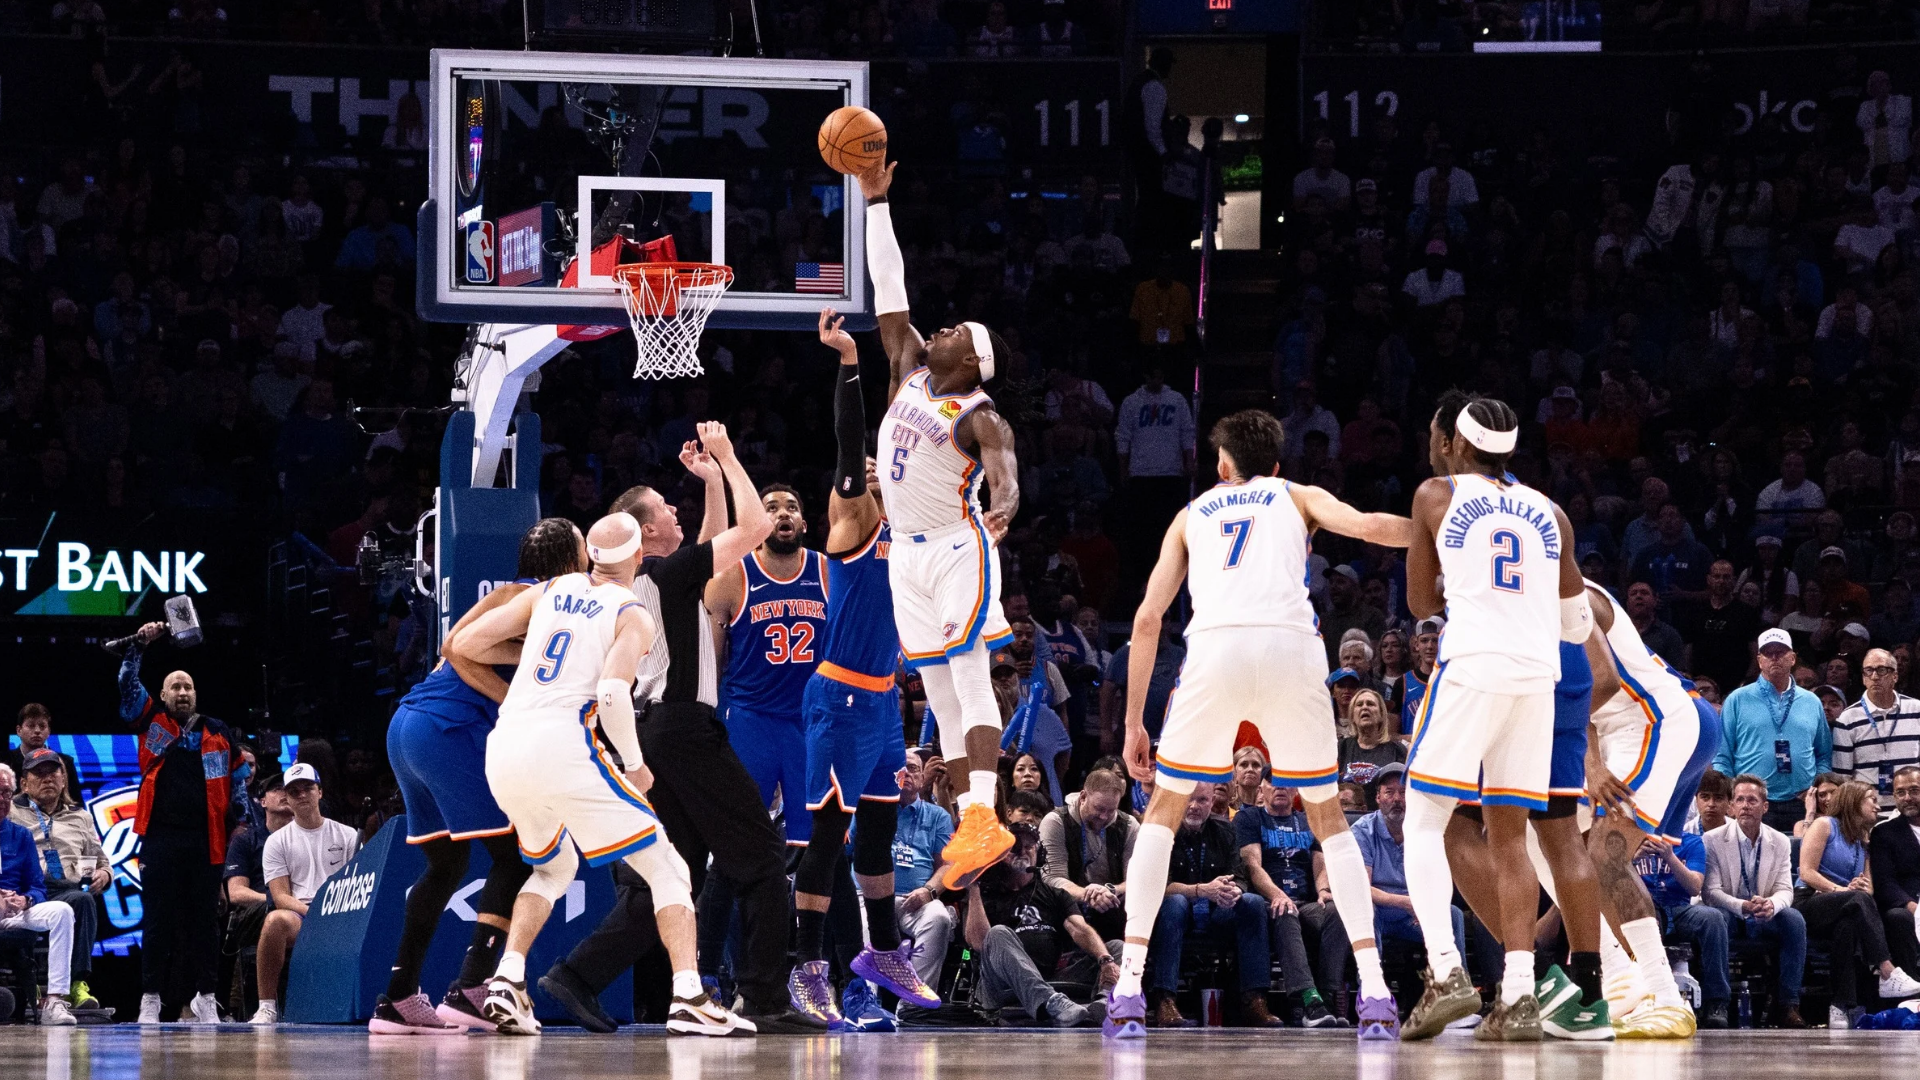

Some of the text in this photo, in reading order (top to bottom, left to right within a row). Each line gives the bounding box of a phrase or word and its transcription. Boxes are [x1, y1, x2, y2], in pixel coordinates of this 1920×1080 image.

[1035, 99, 1109, 146] 111
[470, 268, 484, 279] NBA
[891, 422, 922, 451] CITY
[890, 445, 909, 483] 5
[1199, 489, 1277, 517] HOLMGREN
[1220, 515, 1255, 571] 7
[1444, 495, 1560, 561] GILGEOUS-ALEXANDER
[0, 541, 208, 593] T BANK
[1490, 527, 1524, 594] 2
[750, 599, 827, 625] NEW YORK
[533, 628, 574, 686] 9
[764, 621, 815, 665] 32
[321, 863, 375, 917] coinbase
